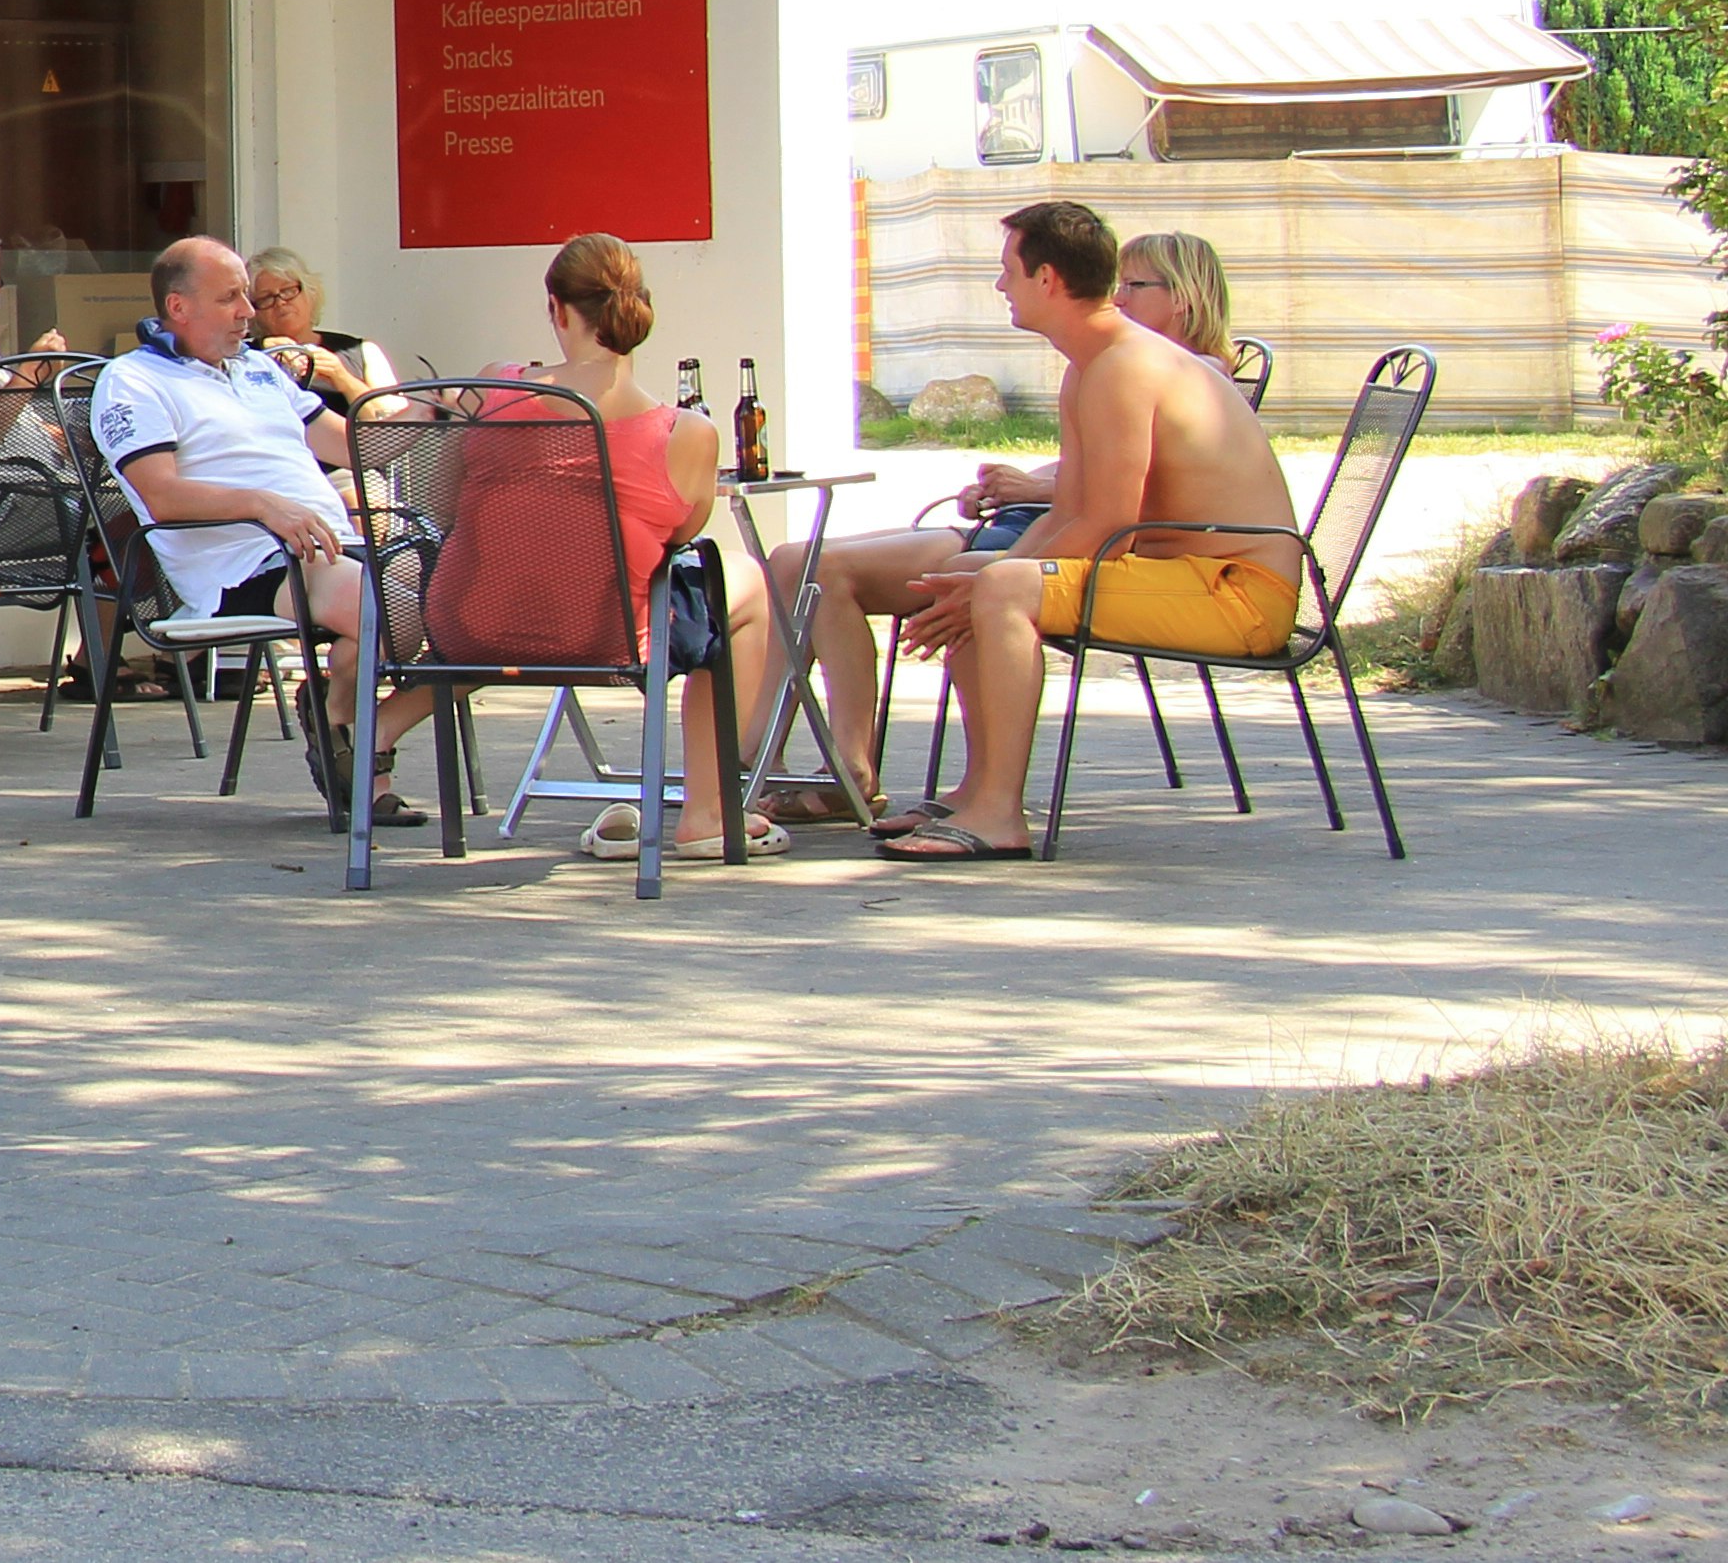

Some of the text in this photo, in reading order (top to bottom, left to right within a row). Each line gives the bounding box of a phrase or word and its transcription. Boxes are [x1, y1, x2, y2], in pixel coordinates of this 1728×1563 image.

[442, 42, 513, 70] Snacks
[443, 84, 605, 120] Eisspezialitäten
[444, 131, 514, 156] Presse
